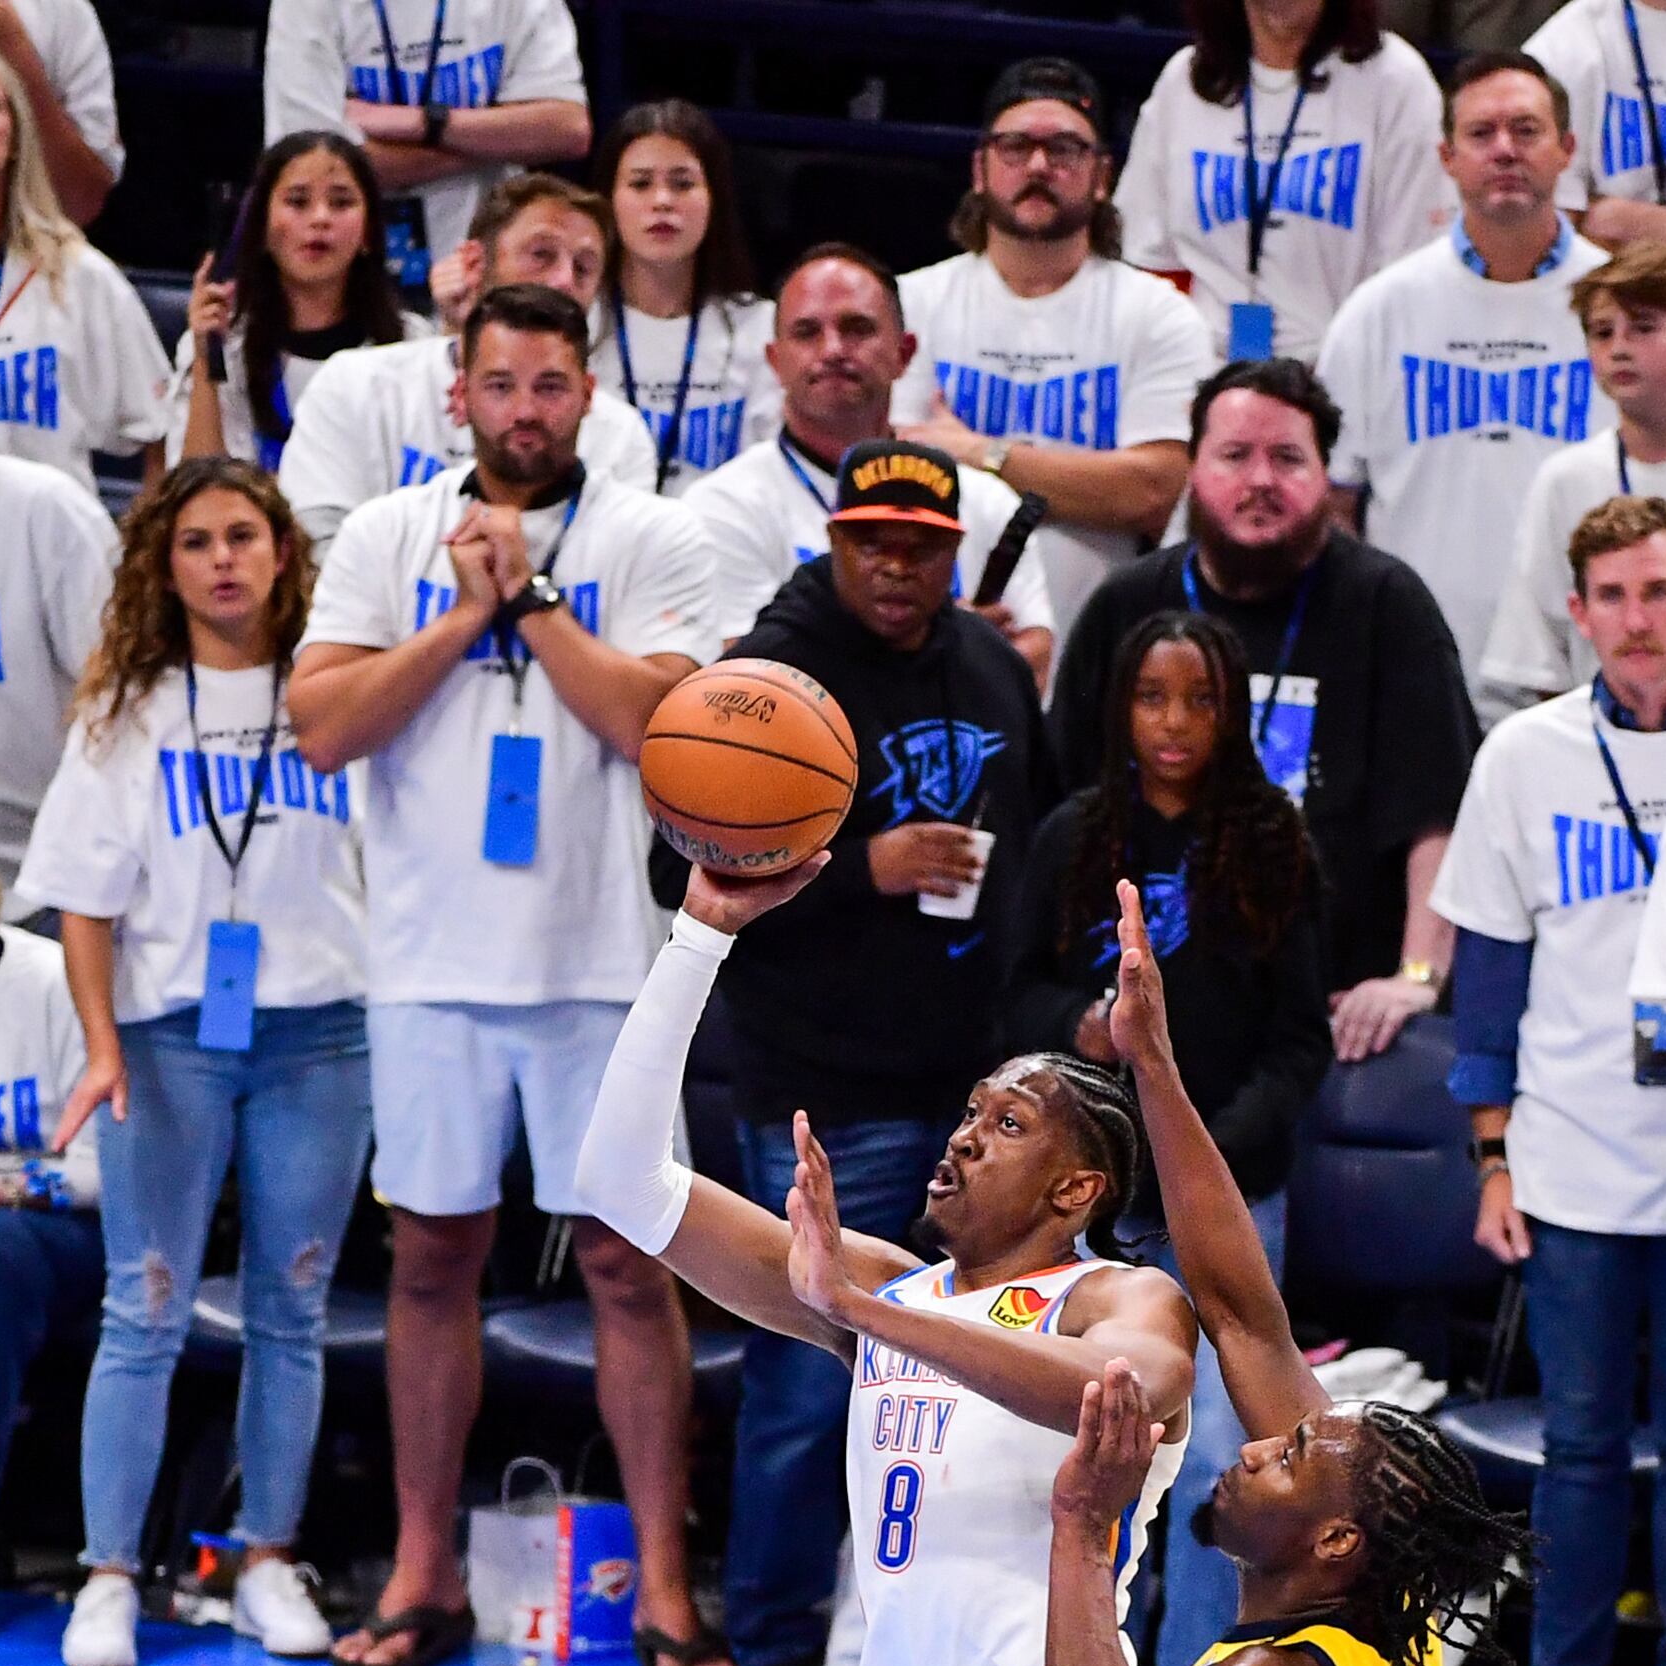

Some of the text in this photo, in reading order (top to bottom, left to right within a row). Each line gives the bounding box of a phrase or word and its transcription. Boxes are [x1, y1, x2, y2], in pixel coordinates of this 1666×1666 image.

[1403, 355, 1591, 444] THUNDER
[873, 1393, 957, 1454] CITY
[874, 1460, 923, 1574] 8
